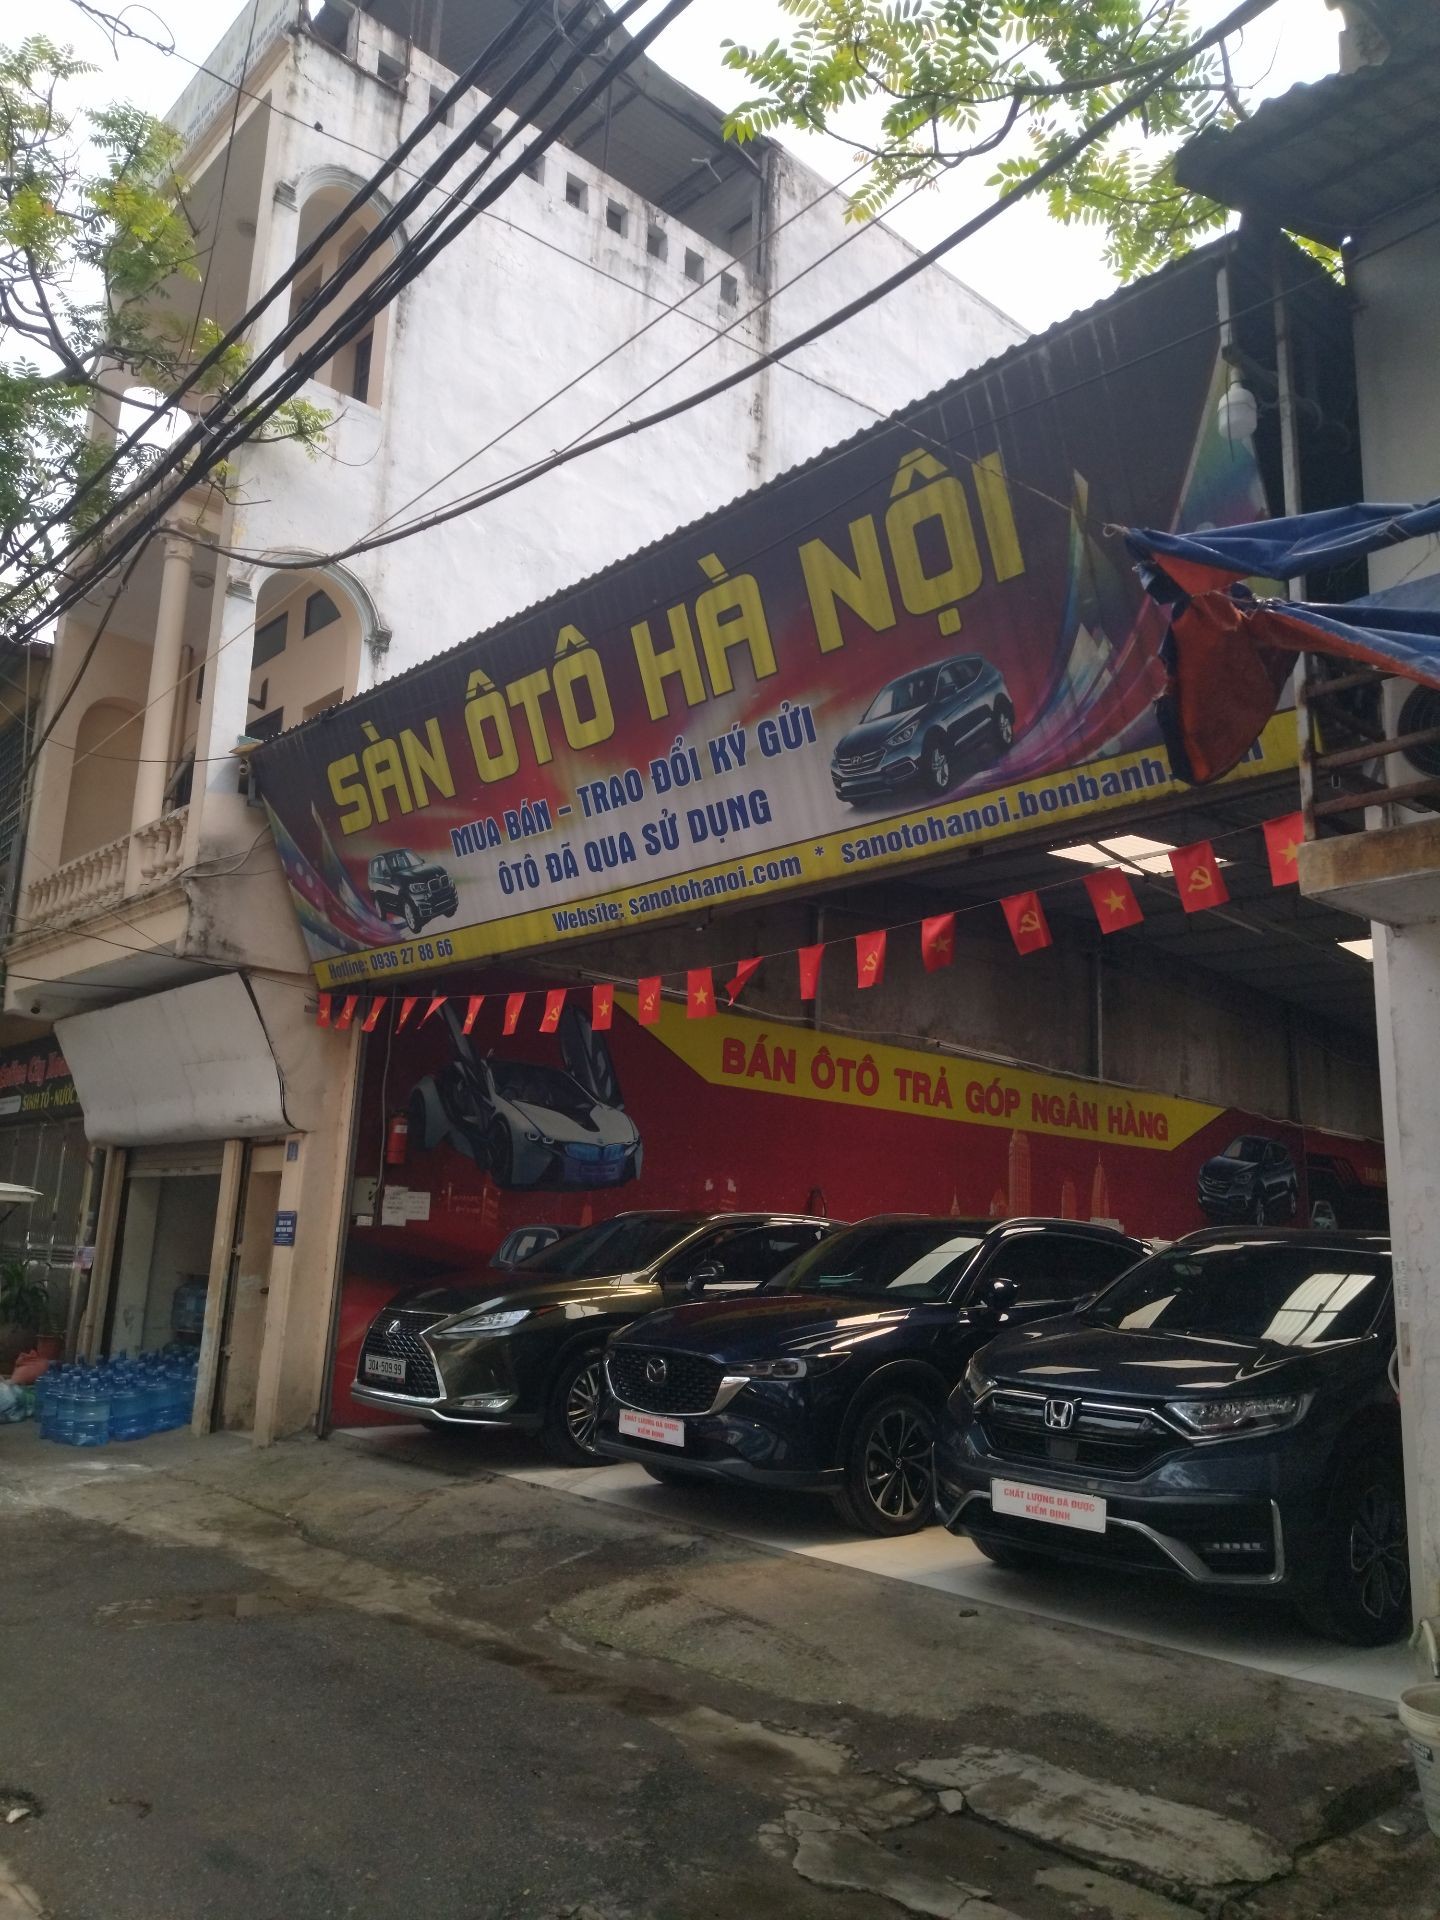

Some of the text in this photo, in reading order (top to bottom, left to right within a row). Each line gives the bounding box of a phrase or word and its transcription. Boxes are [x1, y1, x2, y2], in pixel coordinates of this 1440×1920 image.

[327, 449, 1025, 835] SÀN ÔTÔ HÀ NỘI
[451, 817, 502, 857] MUA
[504, 799, 553, 841] BÁN
[577, 769, 643, 817] TRAO
[650, 736, 702, 794] ĐỔI
[708, 723, 746, 774] KÝ
[757, 701, 816, 757] GỬI
[499, 790, 772, 894] ÔTÔ ĐÃ QUA SỬ DỤNG
[552, 902, 624, 931] Website:
[629, 856, 802, 915] sanotohanoi.com
[328, 939, 453, 979] Hotline: 0936 27 88 66
[722, 1034, 1169, 1141] BÁN ÔTÔ TRẢ GÓP NGÂN HÀNG
[1003, 1486, 1024, 1499] CHẤT
